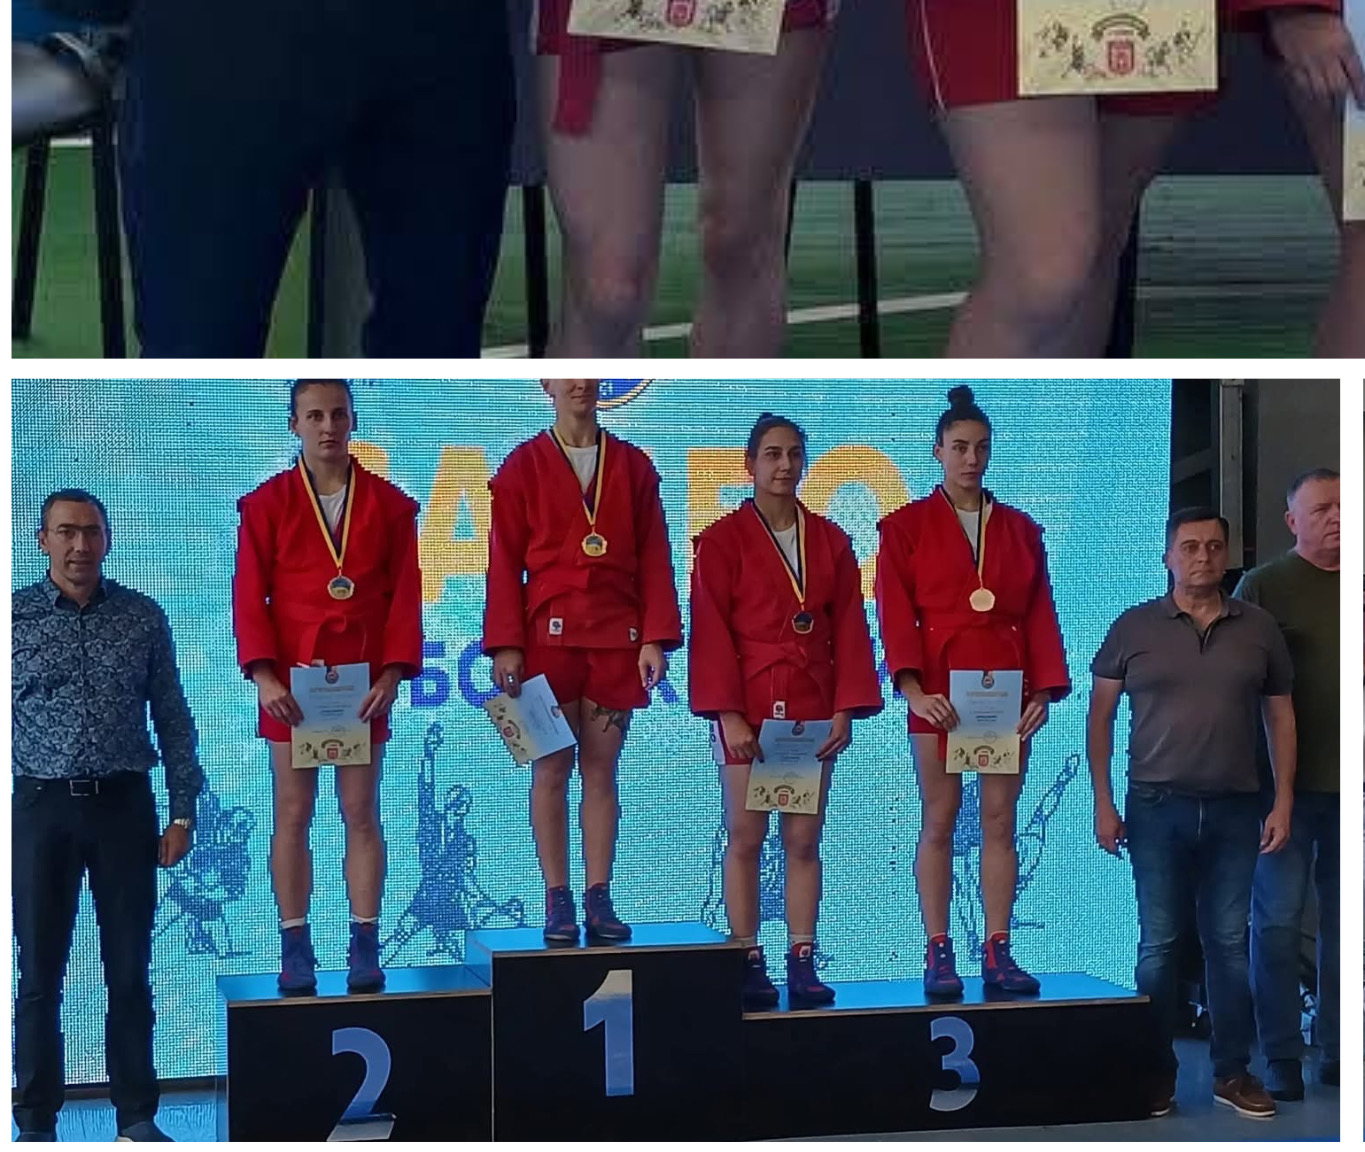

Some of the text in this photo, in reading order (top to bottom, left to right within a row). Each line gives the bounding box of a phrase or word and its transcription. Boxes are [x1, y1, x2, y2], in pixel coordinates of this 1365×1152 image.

[326, 1016, 981, 1141] 2 3
[583, 969, 635, 1098] 1
